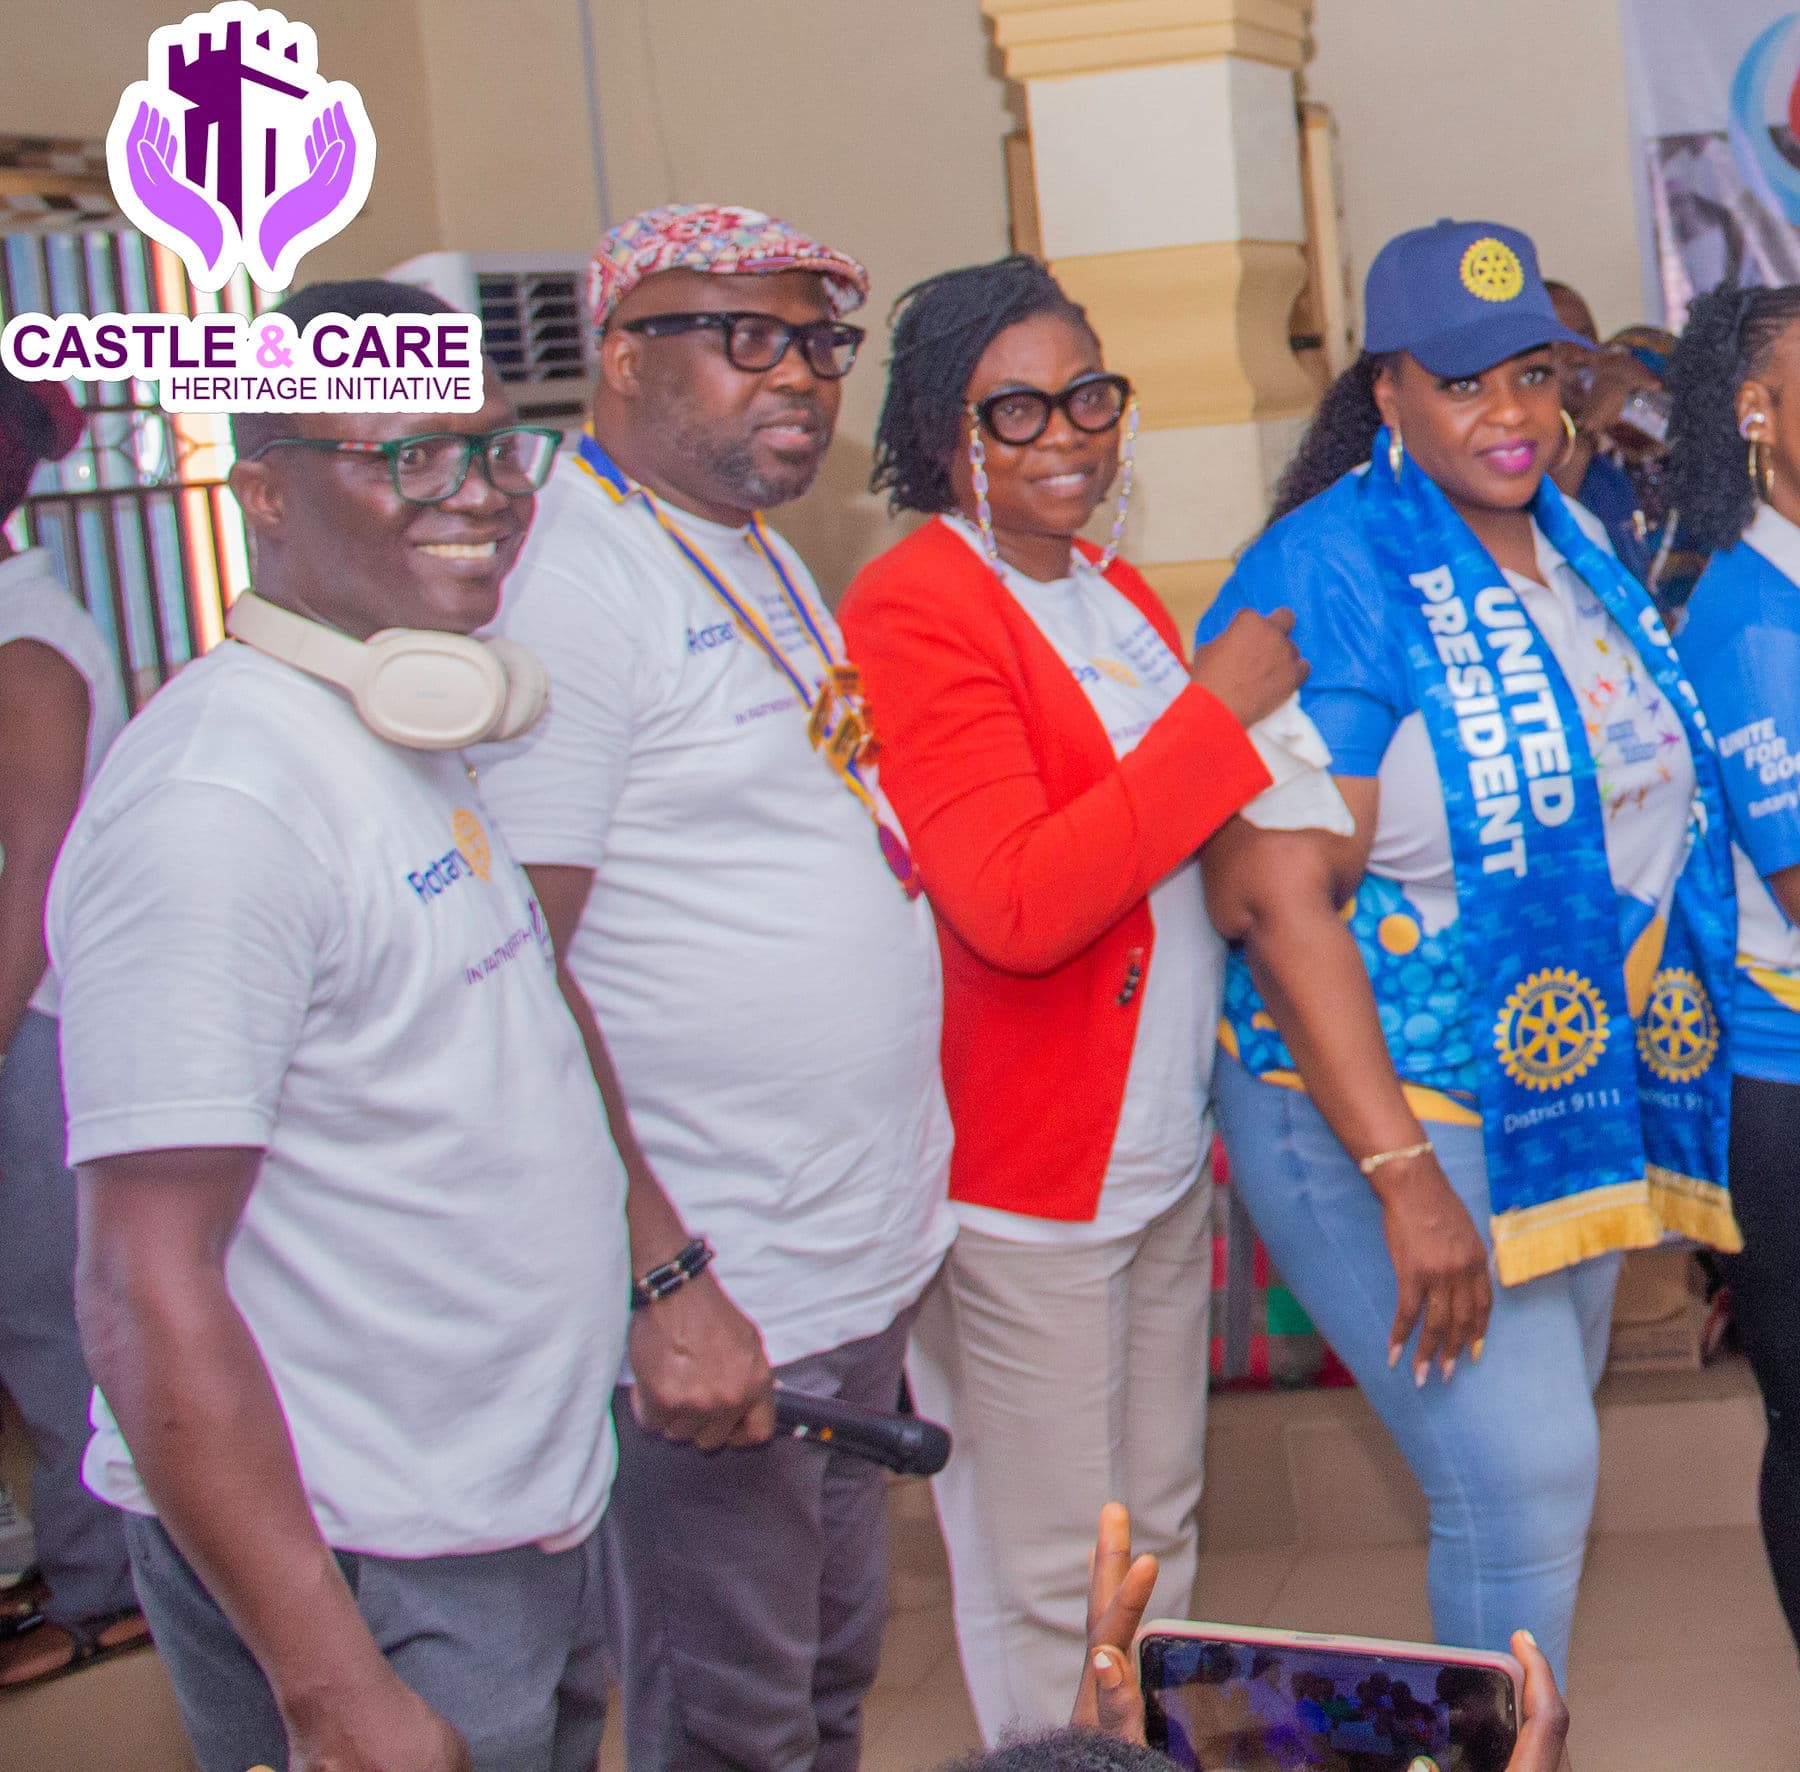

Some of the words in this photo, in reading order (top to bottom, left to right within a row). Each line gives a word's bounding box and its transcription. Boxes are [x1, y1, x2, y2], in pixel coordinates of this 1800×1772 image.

[1408, 564, 1528, 879] PRESIDENT
[1474, 586, 1576, 828] UNITED
[1744, 736, 1787, 770] FOR
[1503, 1097, 1566, 1134] District
[1570, 1087, 1621, 1113] 9111
